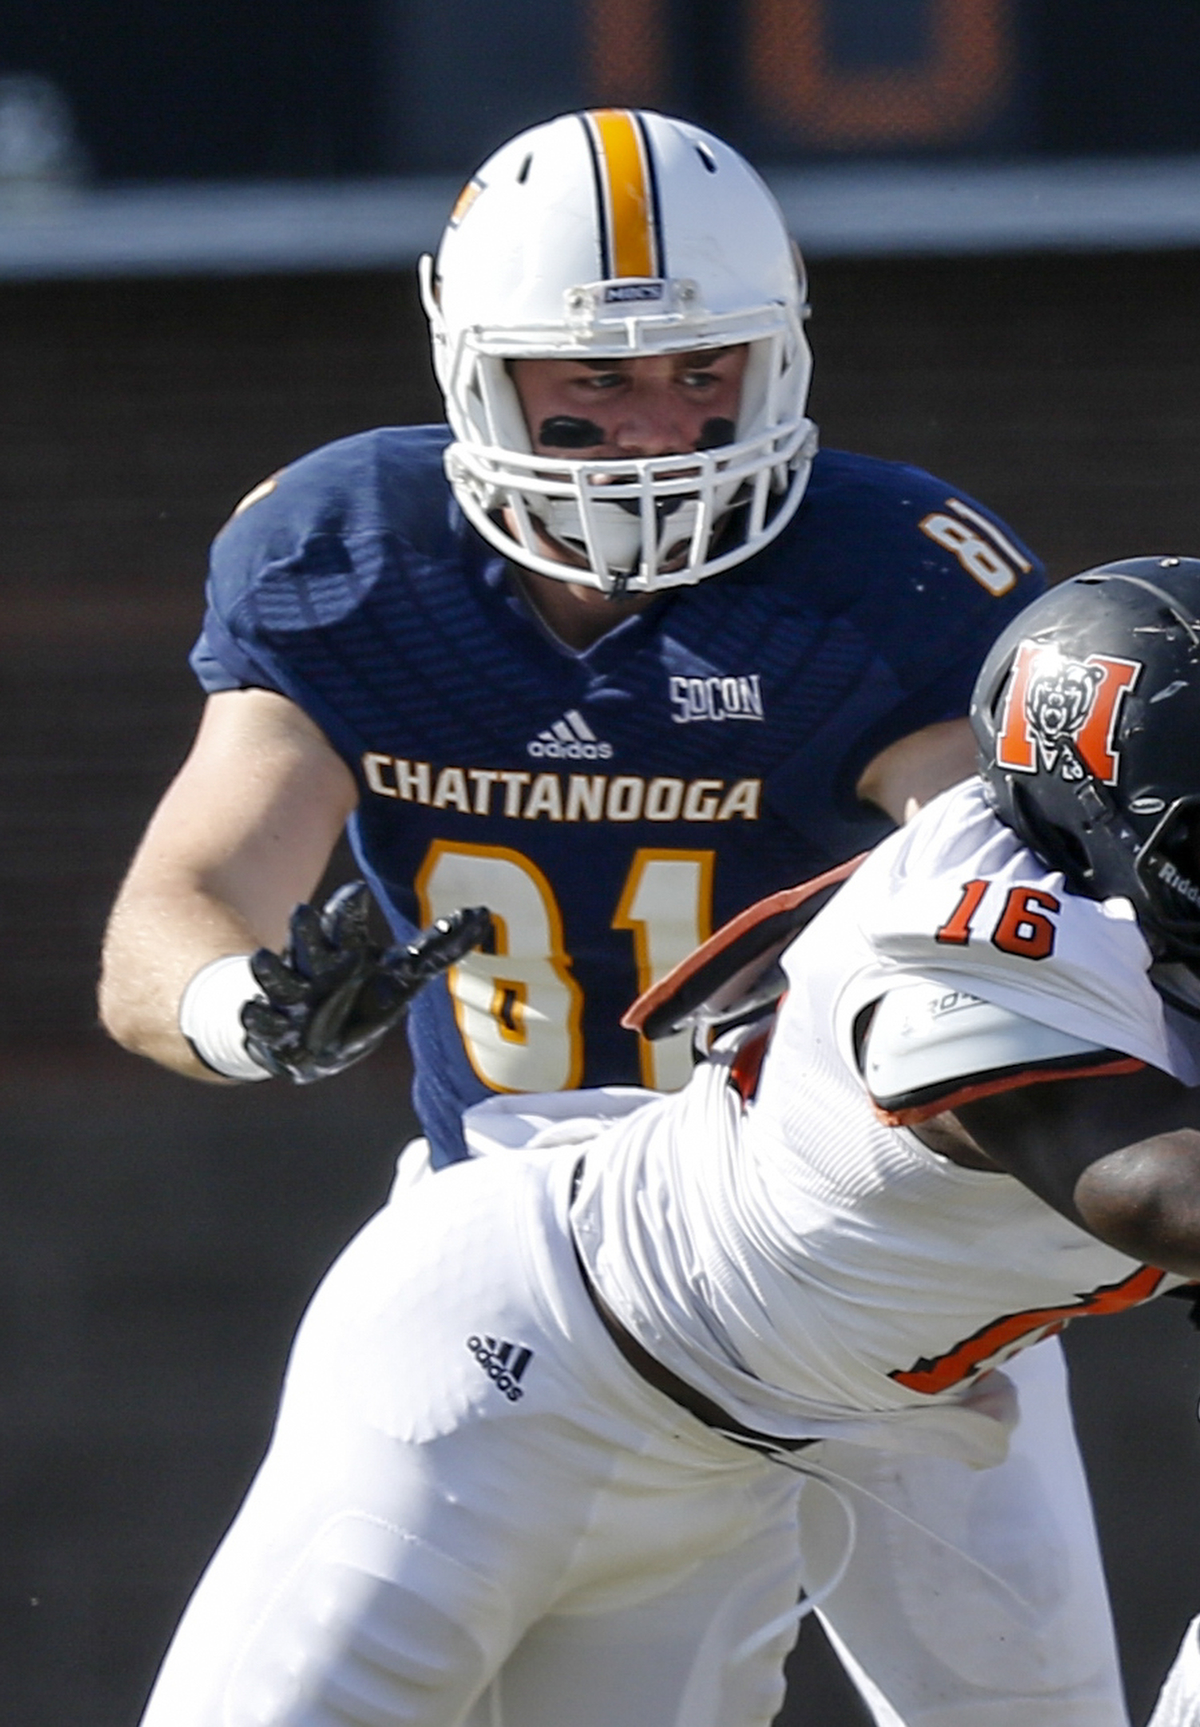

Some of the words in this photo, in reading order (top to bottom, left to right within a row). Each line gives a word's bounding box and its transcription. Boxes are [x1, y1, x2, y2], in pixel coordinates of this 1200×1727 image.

[918, 498, 1032, 597] 81
[669, 674, 764, 724] SOCON
[526, 740, 613, 760] adidas
[362, 752, 762, 823] CHATTANOOGA
[934, 879, 1061, 961] 16
[414, 838, 716, 1093] 81
[466, 1335, 524, 1403] adidas
